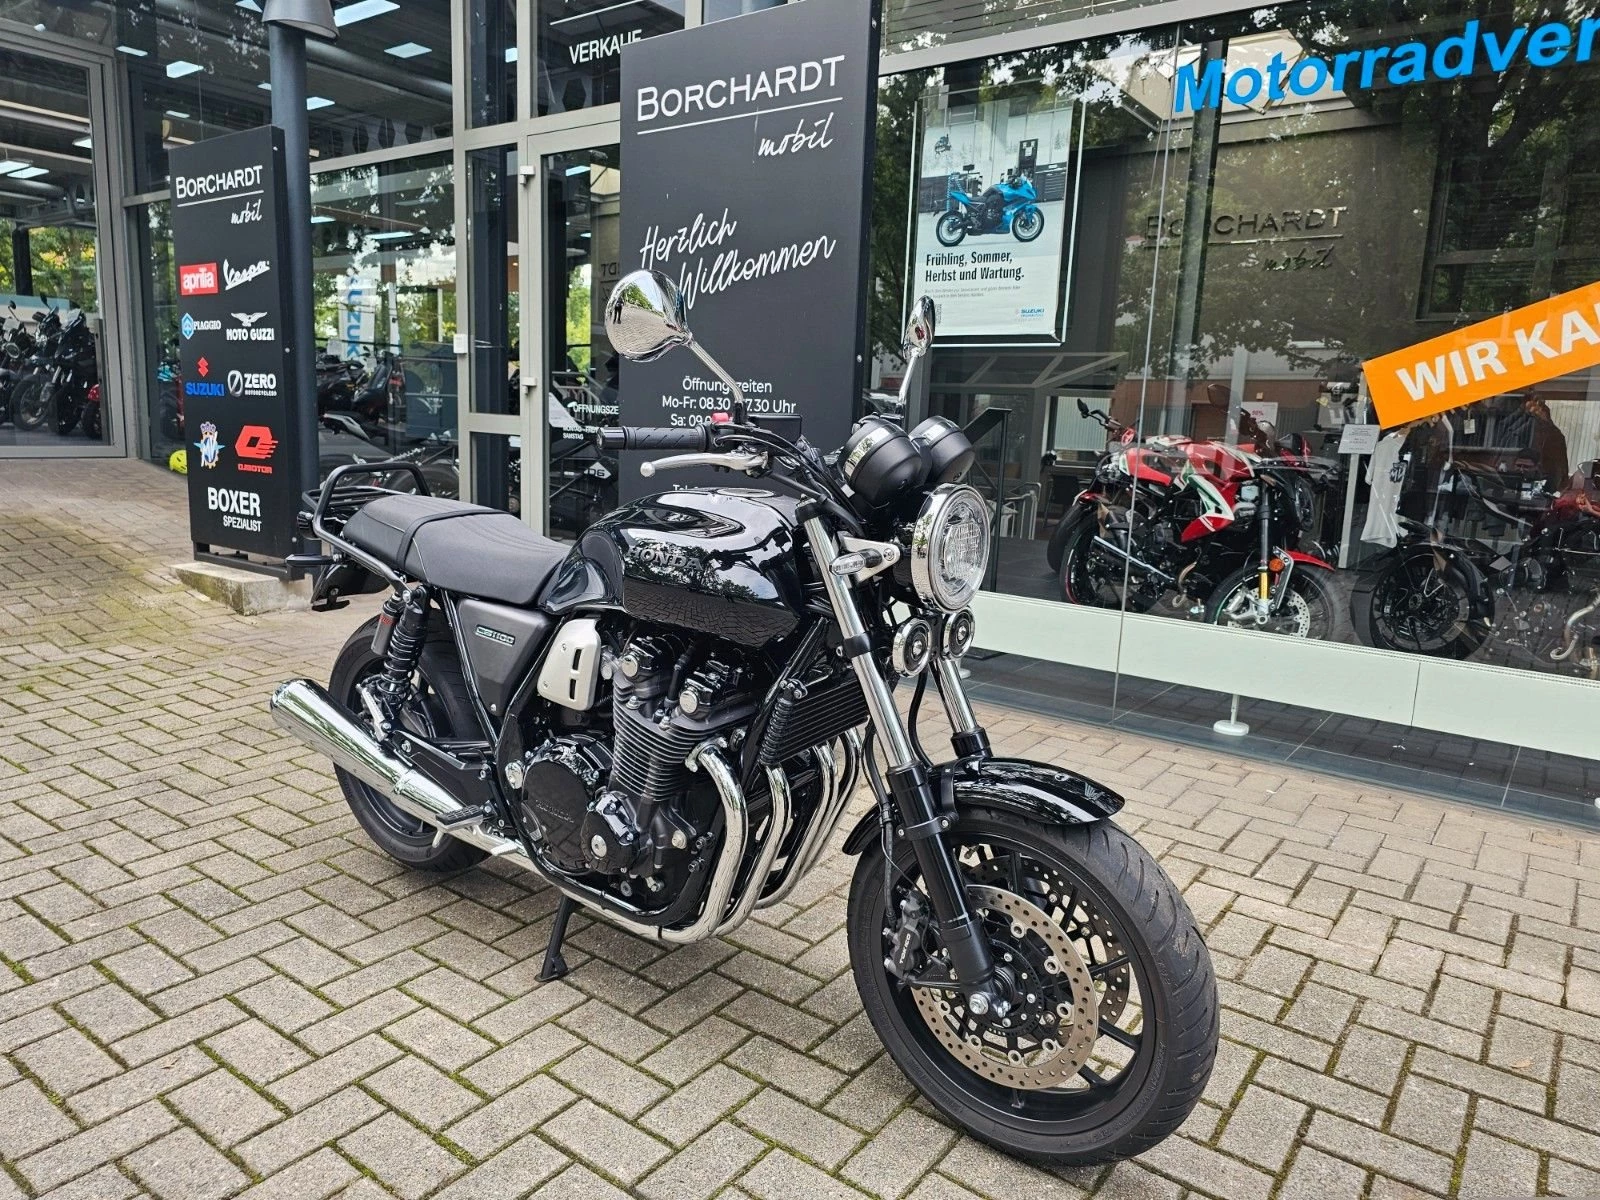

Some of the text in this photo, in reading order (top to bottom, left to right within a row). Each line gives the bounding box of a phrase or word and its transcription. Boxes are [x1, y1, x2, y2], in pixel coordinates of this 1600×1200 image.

[757, 111, 834, 157] mobil
[230, 198, 263, 225] mobil
[639, 207, 738, 270] Herzlich
[926, 250, 1013, 268] Frühling, Sommer,
[182, 266, 215, 294] aprilia
[222, 258, 270, 290] Vespa
[678, 234, 837, 311] Willkommen
[925, 265, 1025, 283] Herbst und Wartung.
[193, 319, 222, 331] PIAGGIO
[226, 327, 275, 341] MOTO GUZZI
[1395, 303, 1600, 401] WIR KA
[185, 381, 225, 397] SUZUKI
[243, 373, 277, 390] ZERO
[699, 396, 731, 411] 08.30
[744, 398, 770, 412] 7.30
[772, 399, 797, 413] Uhr
[670, 413, 687, 426] Sa:
[207, 486, 261, 518] BOXER
[222, 515, 262, 533] SPEZIALIST
